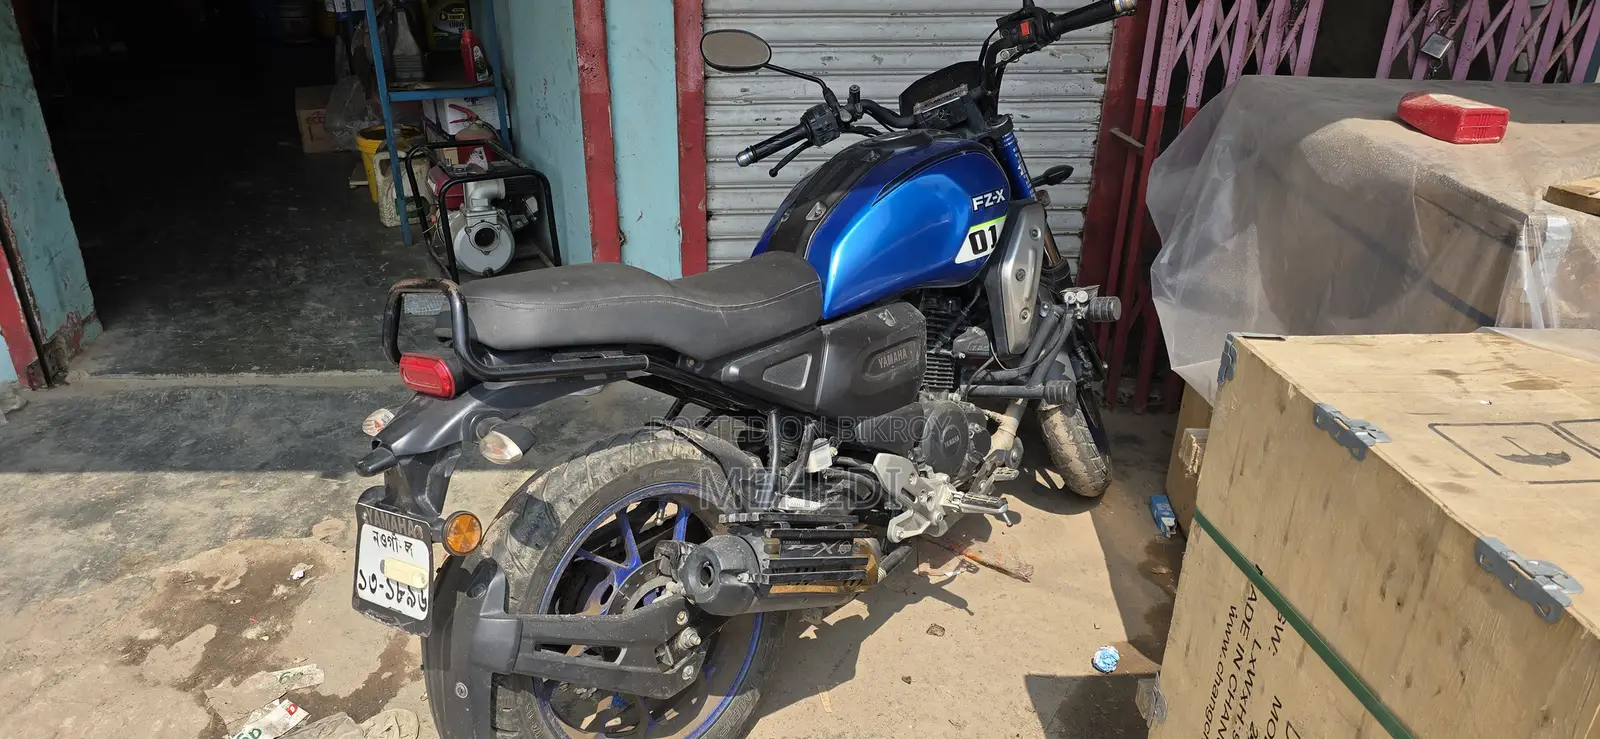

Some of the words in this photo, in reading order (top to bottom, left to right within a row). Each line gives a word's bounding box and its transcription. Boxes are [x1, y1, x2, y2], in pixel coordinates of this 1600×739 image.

[972, 188, 1006, 211] FZ-X
[968, 224, 998, 255] 01
[878, 348, 907, 368] YAMAHA
[365, 507, 416, 537] YAMAHA
[1232, 643, 1245, 670] IN
[1216, 673, 1238, 739] CHAN
[1262, 695, 1282, 739] MO
